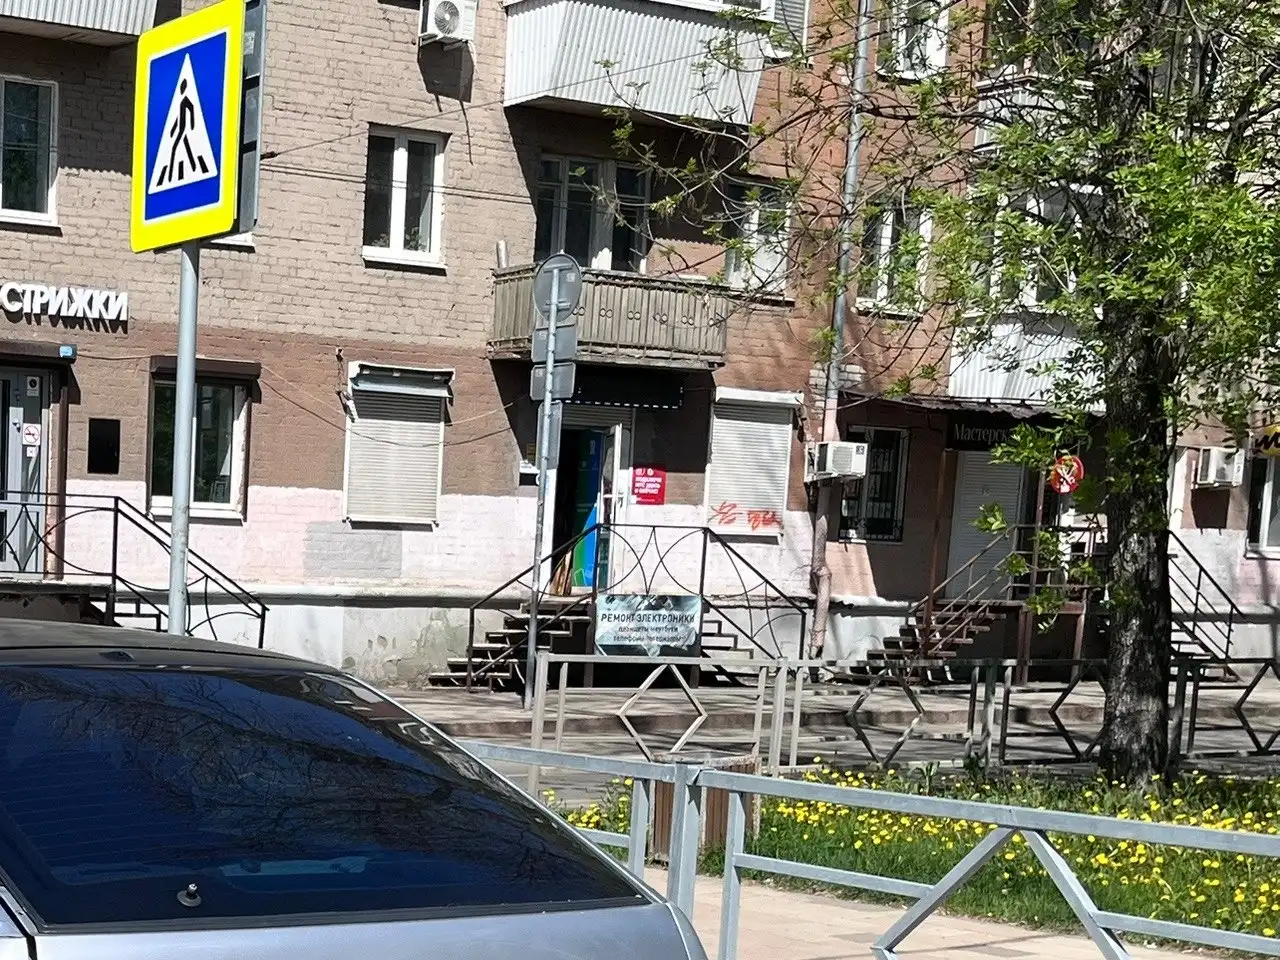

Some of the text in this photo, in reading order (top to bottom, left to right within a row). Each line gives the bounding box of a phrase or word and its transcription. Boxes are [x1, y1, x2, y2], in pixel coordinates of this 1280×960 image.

[0, 282, 128, 321] СТРИЖКИ
[953, 423, 1017, 445] Мастерск
[601, 613, 695, 623] РЕМОНТ ЭЛЕКТРОНИКИ
